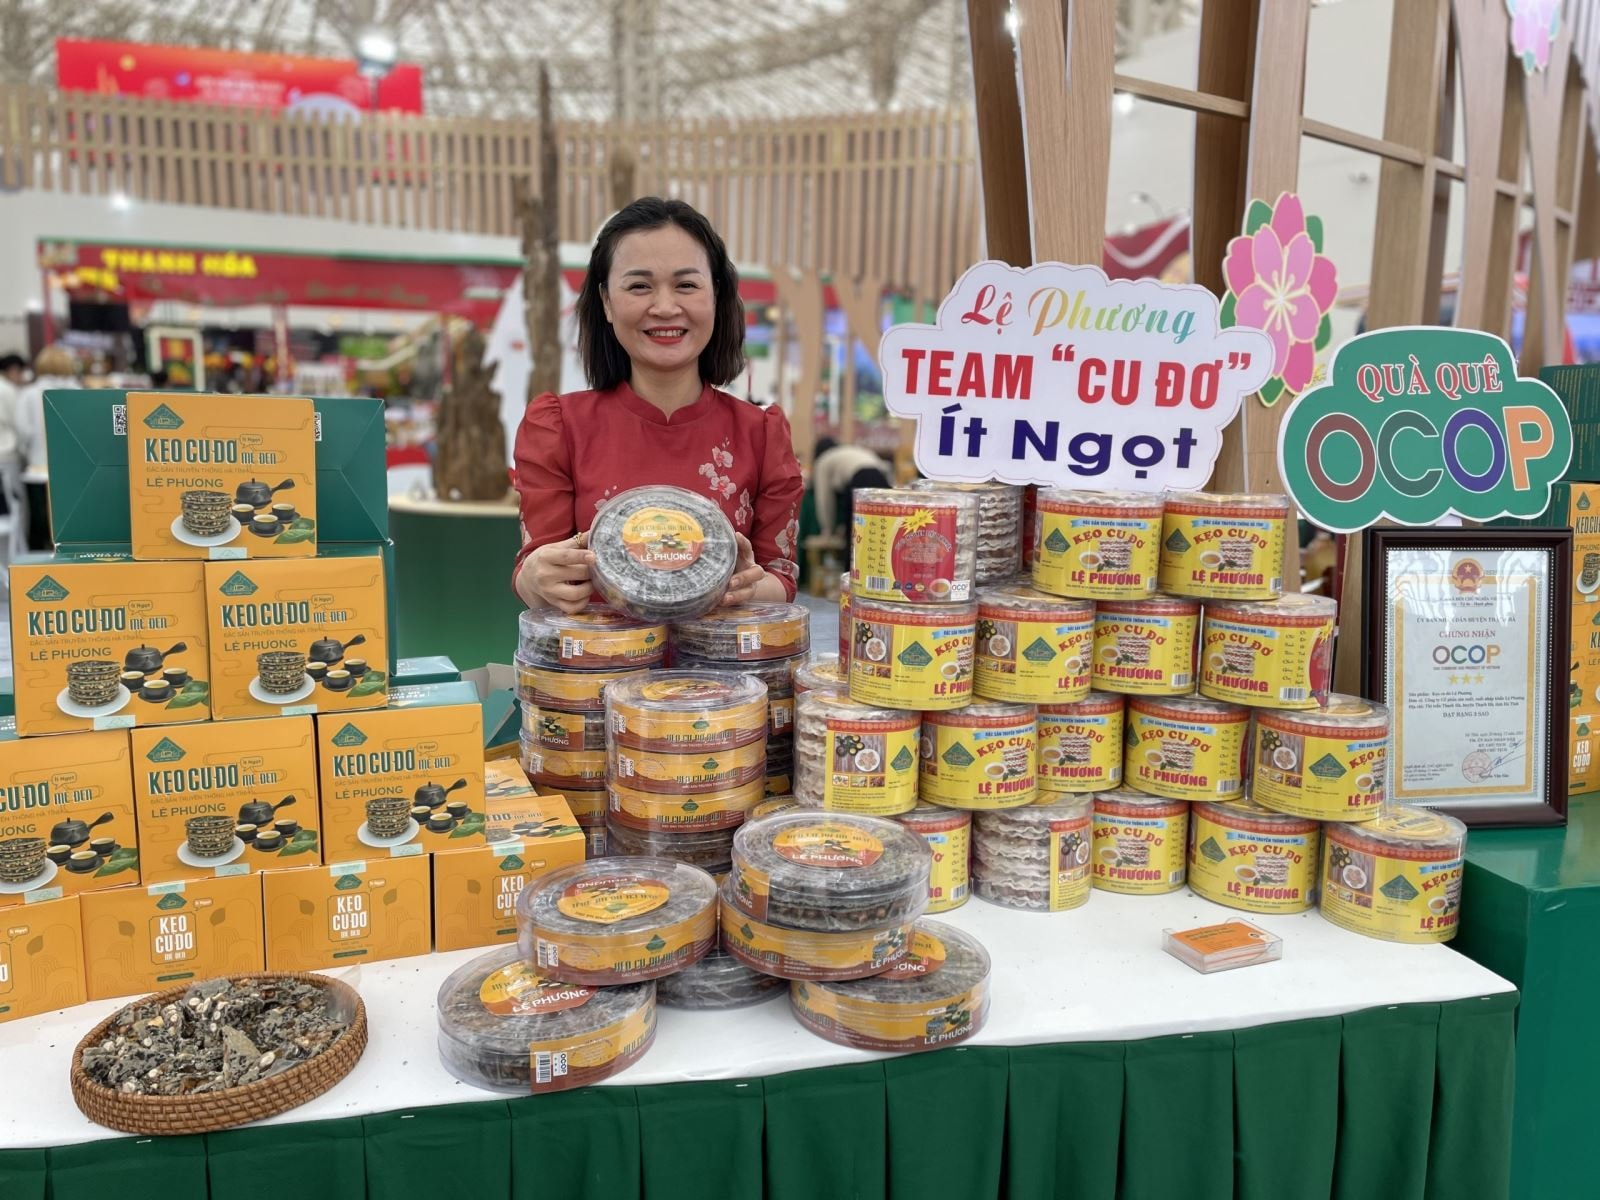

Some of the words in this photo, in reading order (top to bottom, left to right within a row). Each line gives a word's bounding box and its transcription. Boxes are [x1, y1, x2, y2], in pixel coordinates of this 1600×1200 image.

[101, 249, 196, 274] THANH
[202, 249, 258, 279] HÓA
[961, 284, 1014, 335] Lệ
[1028, 287, 1196, 345] Phương
[901, 348, 1034, 401] TEAM
[1356, 353, 1431, 403] QUÀ
[1434, 353, 1503, 401] QUÊ
[938, 402, 988, 458] Ít
[1012, 419, 1198, 479] Ngọt
[1304, 405, 1555, 503] OCOP
[1073, 529, 1102, 545] KẸO
[1106, 528, 1126, 539] CU
[1193, 528, 1223, 544] KẸO
[1228, 528, 1248, 538] CU
[1072, 570, 1085, 584] LỆ
[1089, 572, 1141, 585] PHƯƠNG
[1192, 570, 1206, 584] LỆ
[1210, 572, 1264, 584] PHƯƠNG
[1124, 624, 1144, 635] CU
[1472, 630, 1496, 640] NHẬN
[1230, 634, 1248, 644] CU
[1432, 644, 1500, 664] OCOP
[1094, 663, 1106, 676] LỆ
[1108, 666, 1162, 680] PHƯƠNG
[934, 682, 947, 696] LỆ
[1058, 676, 1070, 690] LỆ
[1205, 670, 1214, 683] LỆ
[1216, 674, 1268, 692] PHƯƠNG
[1066, 725, 1085, 735] CU
[1142, 729, 1164, 741] KẸO
[1168, 730, 1188, 741] CU
[976, 740, 1004, 758] KẸO
[1008, 738, 1024, 746] CU
[1038, 764, 1048, 777] LỆ
[1052, 766, 1102, 778] PHƯƠNG
[1140, 766, 1150, 778] LỆ
[1154, 770, 1208, 786] PHƯƠNG
[978, 781, 992, 796] LỆ
[996, 776, 1034, 794] PHƯƠNG
[1348, 794, 1361, 808] LỆ
[1094, 826, 1119, 840] KẸO
[1124, 827, 1142, 838] CU
[1228, 844, 1258, 858] KẸO
[1262, 844, 1283, 855] CU
[1094, 864, 1105, 878] LỆ
[1110, 866, 1162, 880] PHƯƠNG
[1228, 882, 1241, 896] LỆ
[1246, 886, 1298, 900] PHƯƠNG
[1420, 916, 1434, 930] LỆ
[532, 989, 589, 1008] PHƯƠNG
